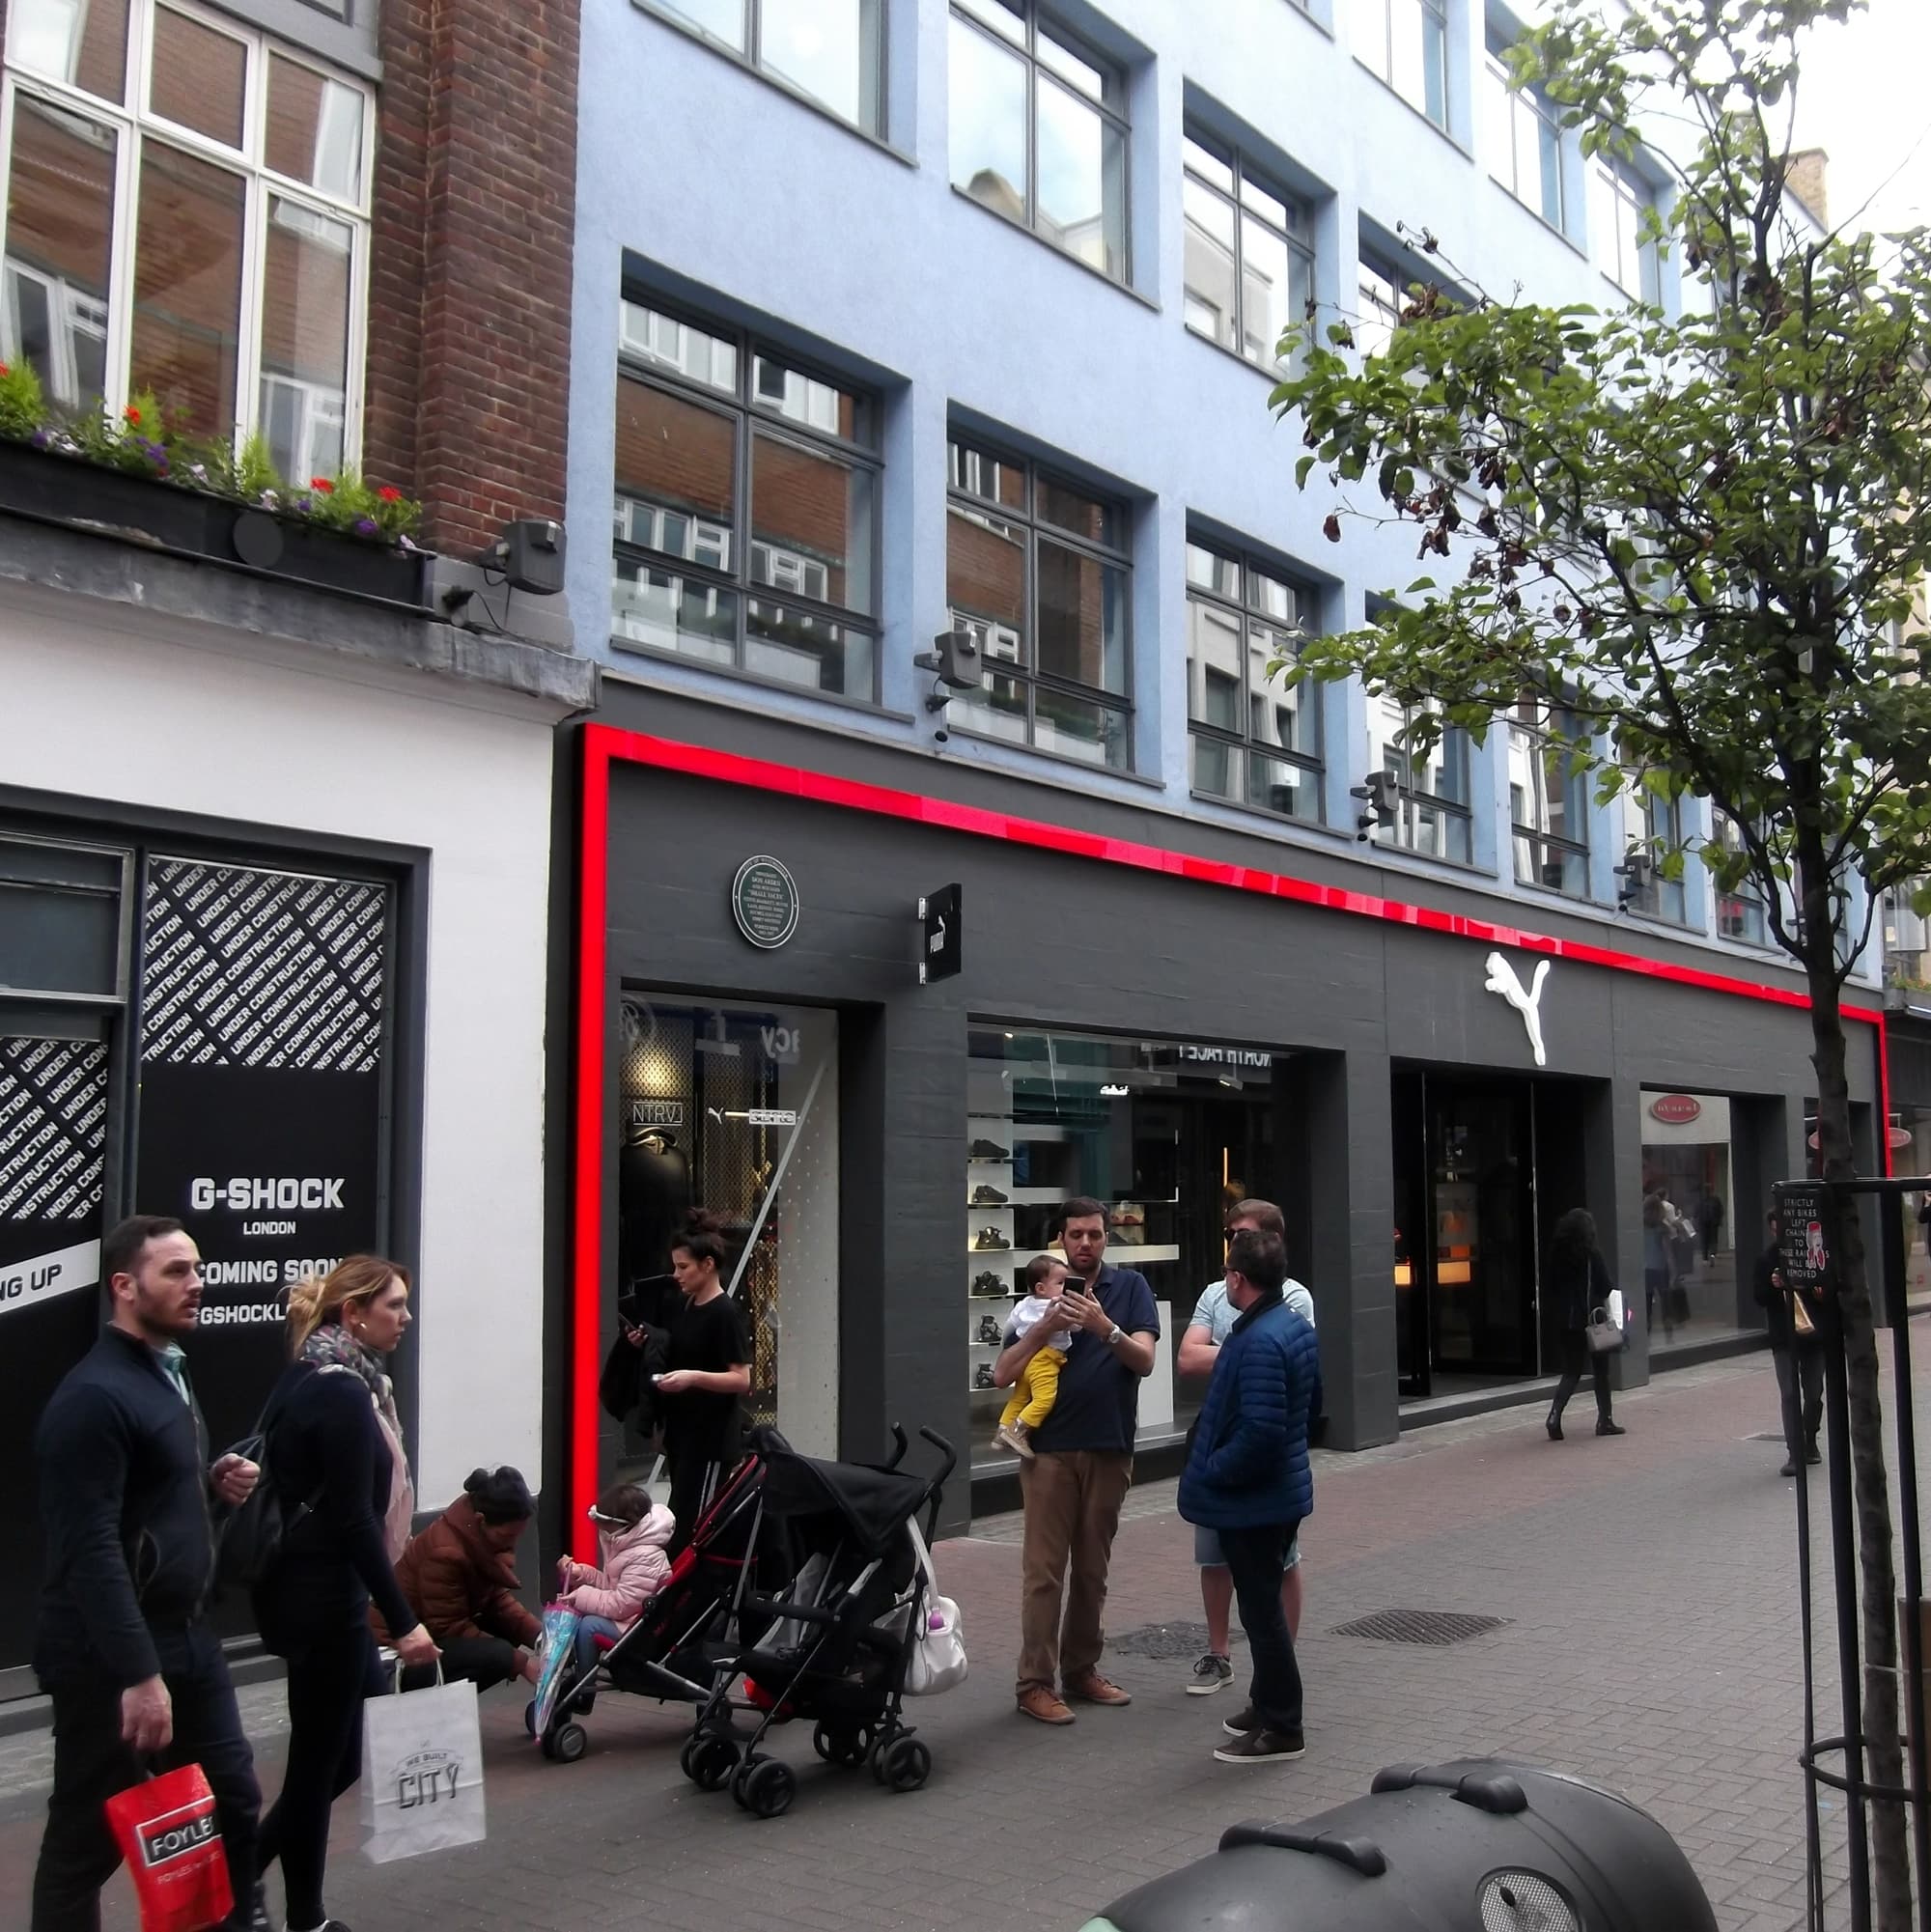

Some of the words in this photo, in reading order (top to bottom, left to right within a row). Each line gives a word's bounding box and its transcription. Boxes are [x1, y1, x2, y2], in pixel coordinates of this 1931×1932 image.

[172, 864, 208, 898] UNDER
[184, 878, 220, 911] UNDER
[294, 881, 327, 911] UNDER
[196, 894, 231, 928] UNDER
[228, 872, 260, 899] CONS
[306, 895, 338, 927] UNDER
[209, 910, 242, 944] UNDER
[220, 924, 255, 959] UNDER
[317, 909, 349, 941] UNDER
[328, 922, 359, 954] UNDER
[194, 977, 229, 1012] UNDER
[225, 911, 294, 981] CONSTRUCTION
[338, 937, 369, 969] UNDER
[350, 952, 379, 984] UNDER
[142, 944, 208, 1015] ONSTRUCTION
[206, 993, 240, 1027] UNDER
[238, 927, 305, 996] CONSTRUCTION
[218, 1007, 252, 1042] UNDER
[249, 941, 317, 1011] CONSTRUCTION
[147, 959, 219, 1031] CONSTRUCTION
[231, 1021, 265, 1055] UNDER
[262, 954, 328, 1023] CONSTRUCTION
[272, 969, 338, 1039] CONSTRUCTION
[284, 985, 349, 1054] CONSTRUCTION
[295, 997, 359, 1068] CONSTRUCTION
[34, 1050, 73, 1087] UNDER
[46, 1067, 86, 1104] UNDER
[60, 1082, 98, 1120] UNDER
[0, 1121, 59, 1186] STRUCTION
[0, 1135, 72, 1217] ONSTRUCTION
[191, 1177, 346, 1210] G-SHOCK
[242, 1221, 296, 1235] LONDON
[1785, 1228, 1807, 1237] CHAIN
[1791, 1218, 1805, 1227] LEFT
[1795, 1239, 1805, 1247] TO
[30, 1263, 63, 1292] UP
[197, 1303, 292, 1326] GSHOCKL
[398, 1762, 460, 1809] CITY
